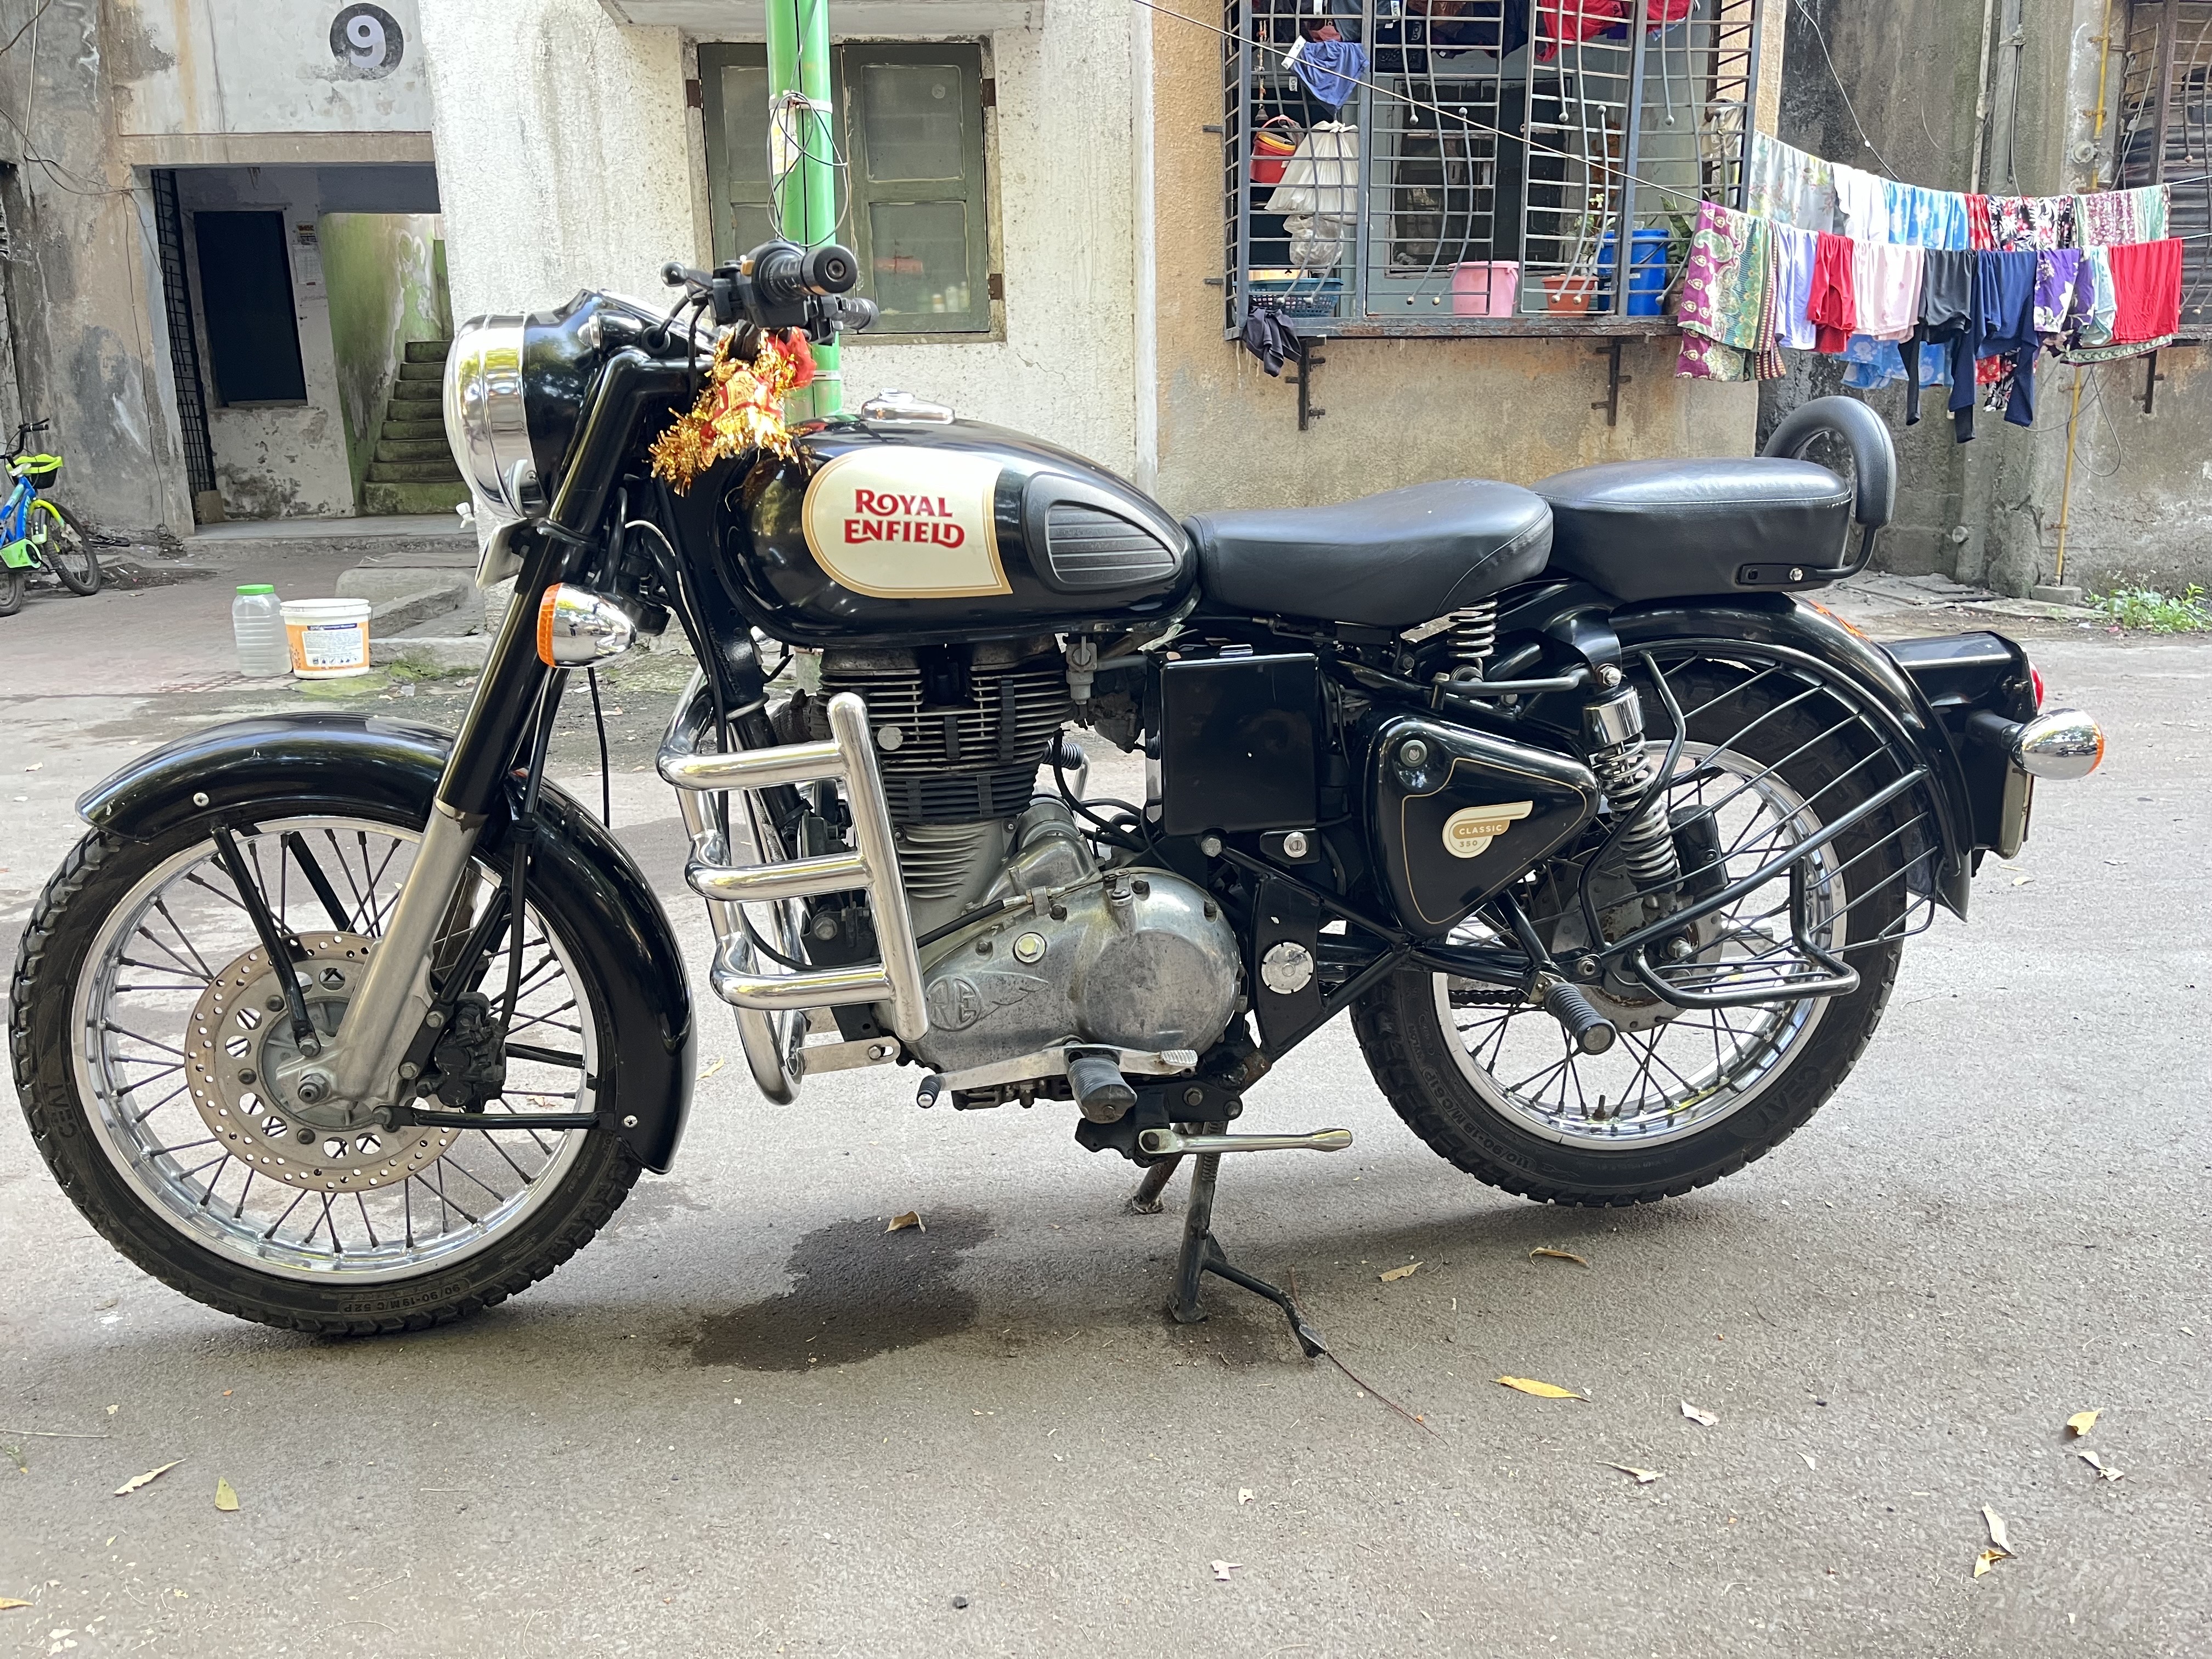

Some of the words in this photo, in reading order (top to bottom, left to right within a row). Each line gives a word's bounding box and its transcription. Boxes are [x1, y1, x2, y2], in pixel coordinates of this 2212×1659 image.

[346, 15, 387, 67] 9
[854, 488, 953, 517] ROYAL
[844, 518, 965, 549] ENFIELD
[1458, 824, 1503, 835] CLASSIC
[43, 1081, 78, 1138] CEAT
[1463, 1122, 1530, 1170] 110/90-18
[343, 1304, 372, 1312] 52P
[376, 1300, 400, 1311] M/C
[402, 1284, 461, 1309] 90/90-19
